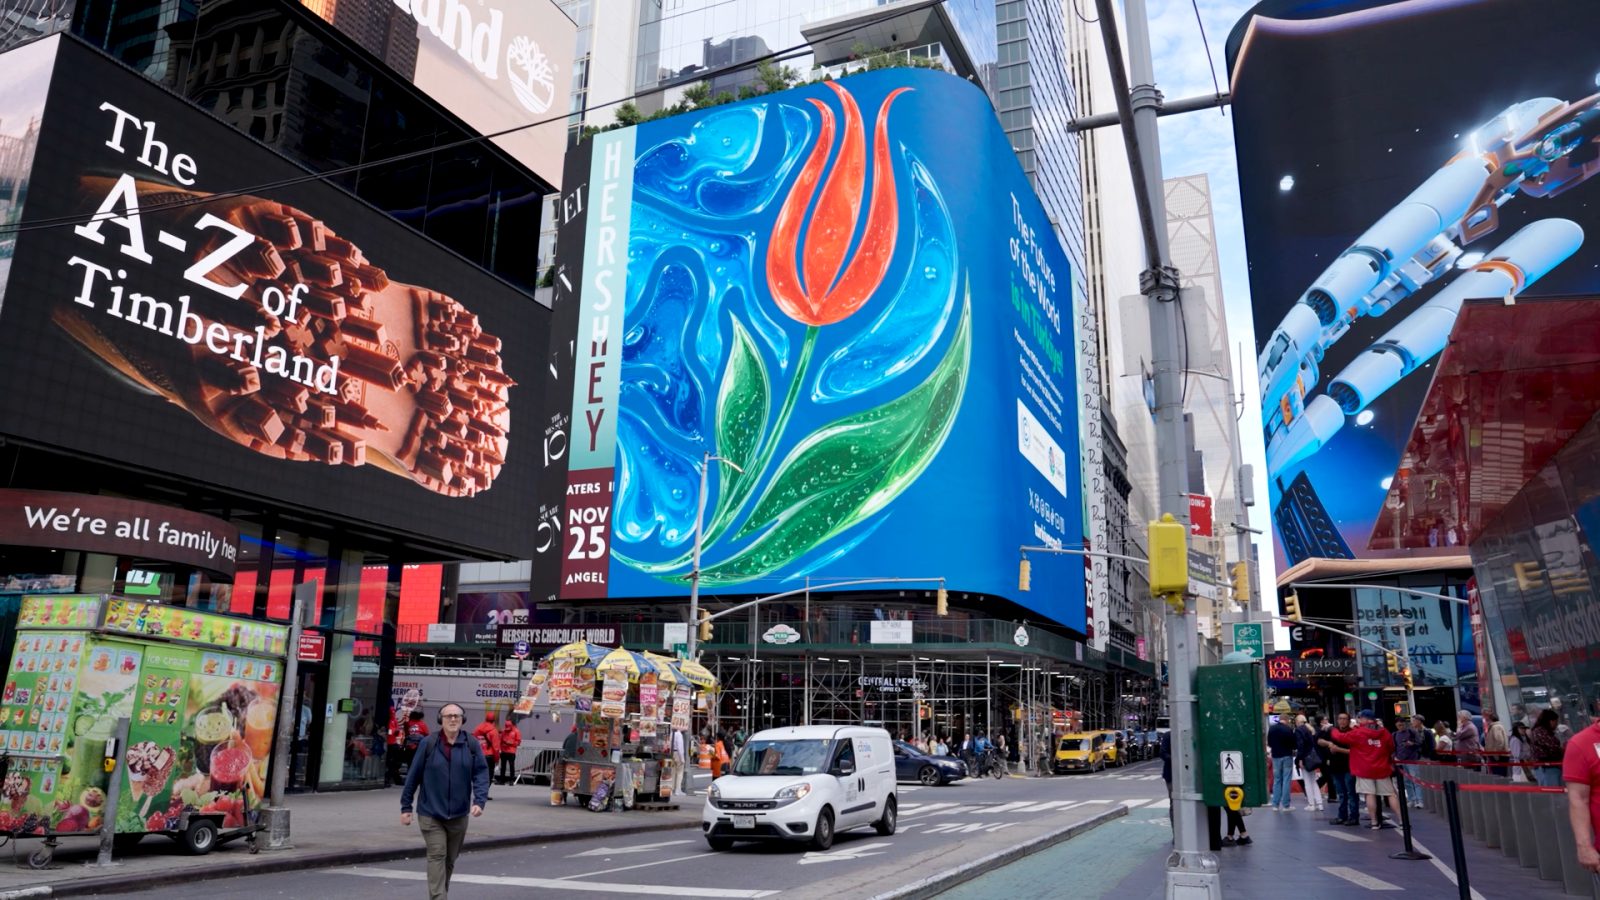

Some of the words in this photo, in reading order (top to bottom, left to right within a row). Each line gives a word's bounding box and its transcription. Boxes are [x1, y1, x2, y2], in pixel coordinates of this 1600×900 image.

[99, 101, 198, 186] The
[74, 173, 255, 300] A-Z
[262, 283, 309, 324] of
[1010, 192, 1029, 245] The
[1030, 227, 1056, 293] Future
[586, 141, 621, 453] HERSHEY
[1021, 252, 1036, 293] the
[1036, 273, 1061, 335] World
[67, 256, 339, 395] Timberland
[566, 482, 601, 495] ATERS
[24, 505, 107, 535] We're
[115, 517, 150, 541] all
[158, 522, 219, 559] family
[569, 506, 609, 524] NOV
[567, 525, 606, 560] 25
[566, 572, 605, 585] ANGEL
[502, 628, 541, 644] HERSHEY'S
[541, 628, 585, 644] CHOCOLATE
[586, 628, 615, 644] WORLD
[858, 676, 894, 686] CENTRAL
[1298, 660, 1341, 668] TEMPO
[476, 689, 522, 698] CELEBRATES
